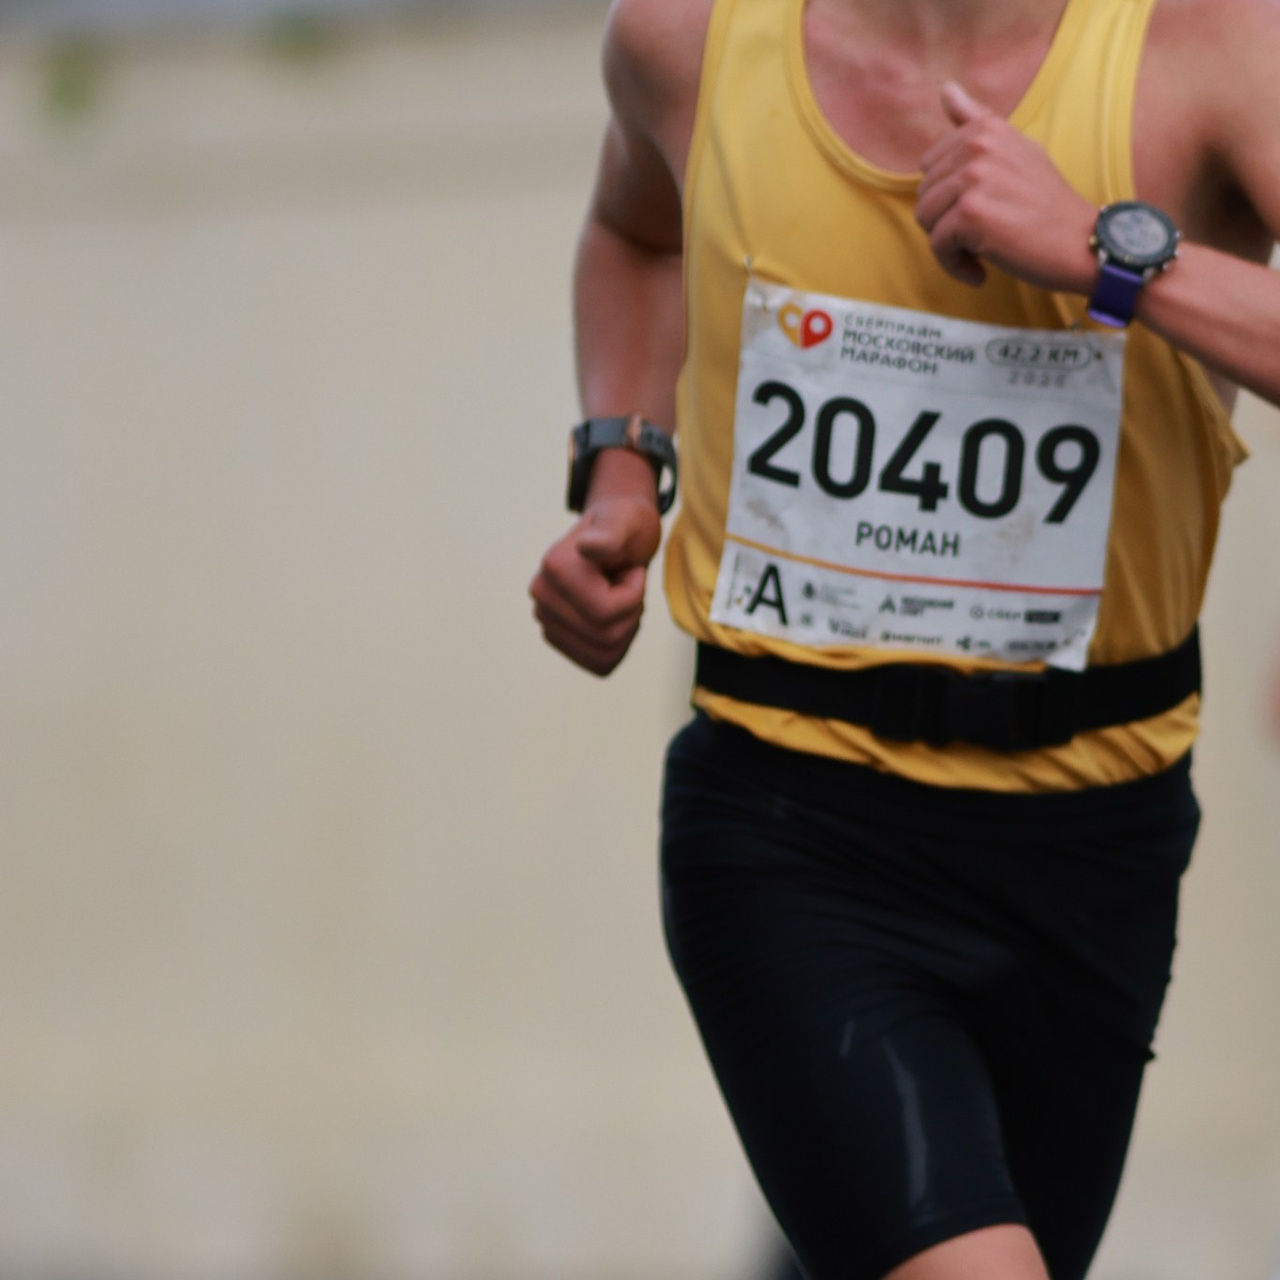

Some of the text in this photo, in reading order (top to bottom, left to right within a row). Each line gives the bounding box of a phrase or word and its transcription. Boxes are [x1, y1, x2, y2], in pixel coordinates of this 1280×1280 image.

[840, 346, 939, 375] МАРАФОН
[842, 328, 976, 363] МОСКОВСКИЙ
[746, 379, 1101, 524] 20409
[855, 521, 961, 558] РОМАН
